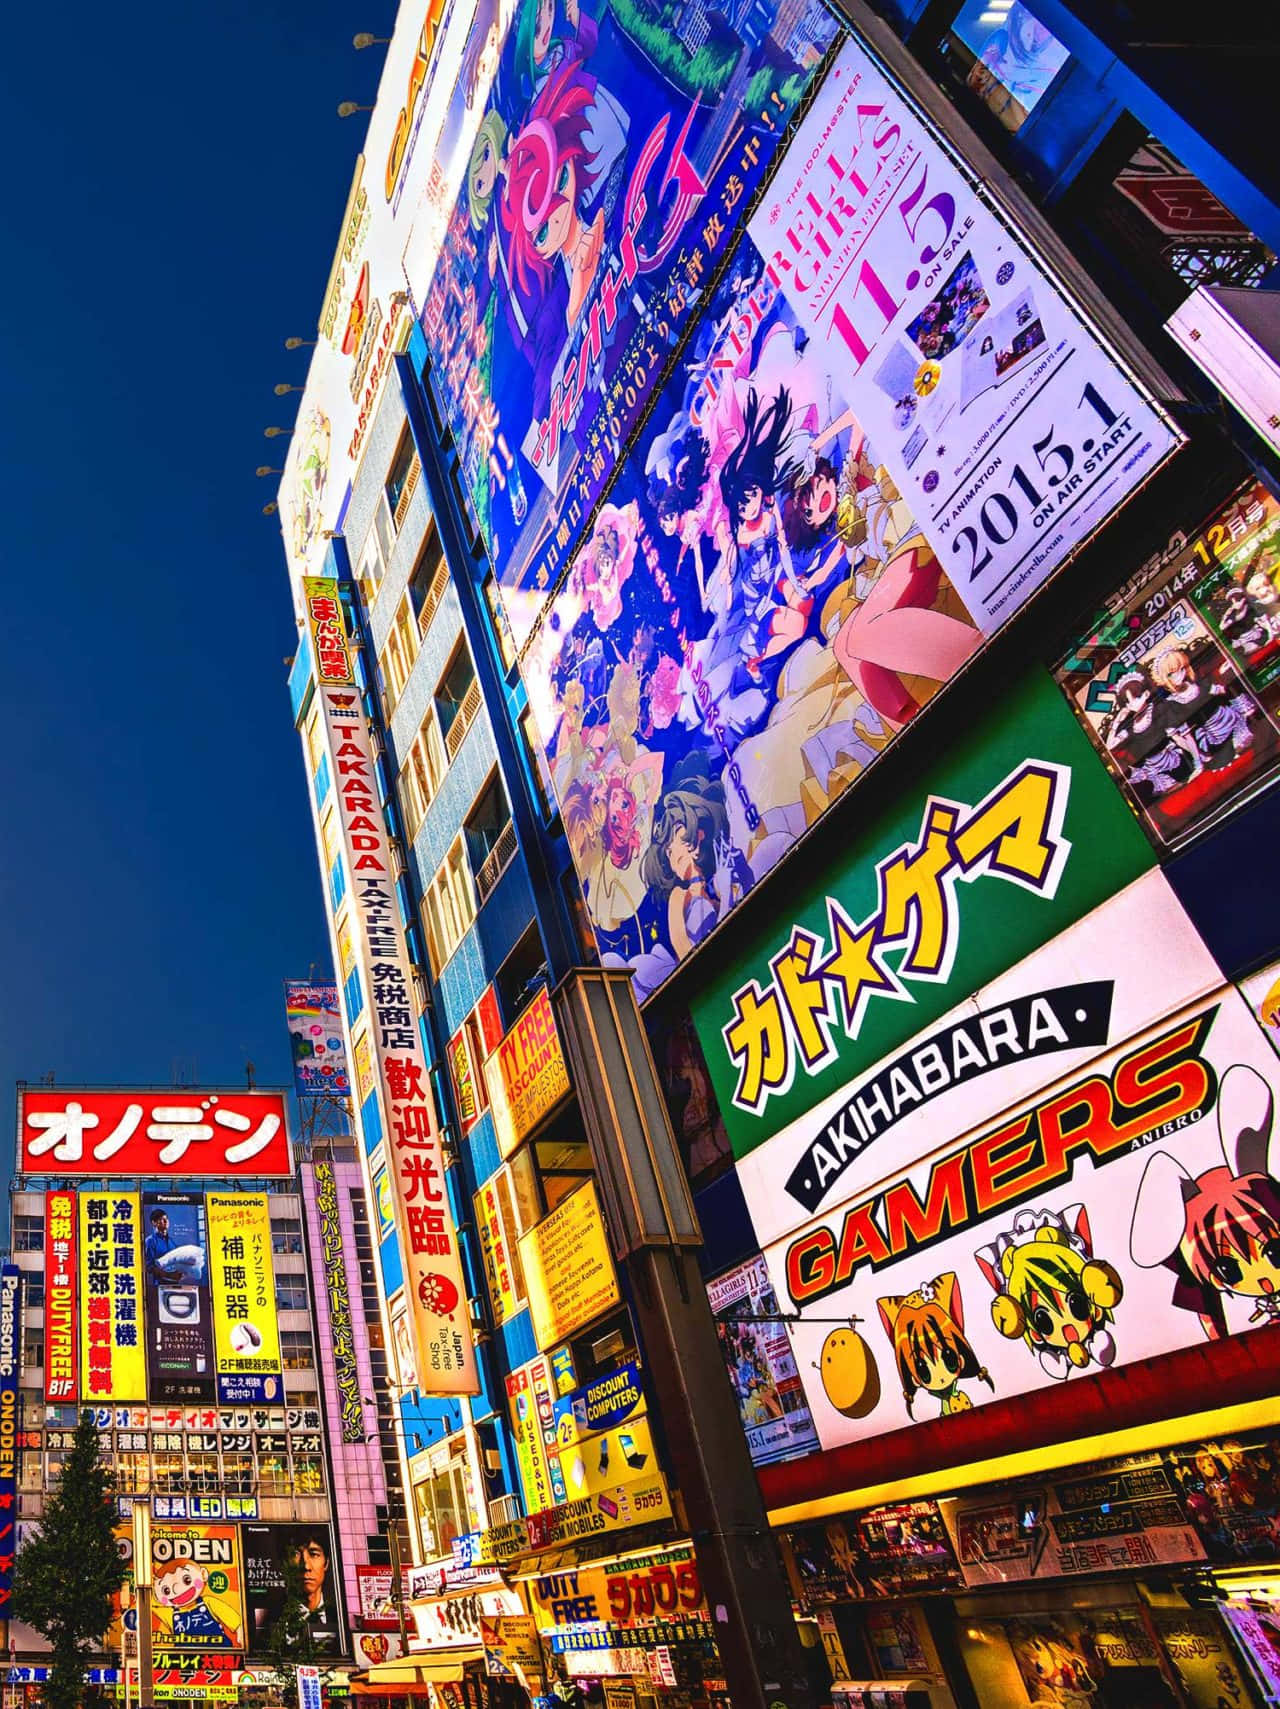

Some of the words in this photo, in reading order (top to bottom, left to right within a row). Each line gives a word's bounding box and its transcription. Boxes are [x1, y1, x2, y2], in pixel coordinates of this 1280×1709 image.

[785, 180, 805, 207] THE
[803, 70, 864, 176] IDOLM@STER
[793, 114, 902, 295] GIRLS
[687, 100, 887, 429] CINDERELLA
[826, 162, 956, 378] 11.5
[923, 262, 943, 290] ON
[942, 214, 977, 262] SALE
[530, 91, 786, 597] 週日曜日午前10:00より好評放送中!!
[937, 516, 953, 535] TV
[950, 456, 1003, 521] ANIMATION
[951, 380, 1126, 585] 2015.1
[1032, 504, 1056, 530] ON
[1057, 473, 1084, 505] AIR
[1083, 415, 1134, 475] START
[987, 532, 1065, 618] imas-cinderella.com
[310, 597, 352, 680] まんが喫茶
[331, 724, 387, 872] TAKARADA
[357, 877, 399, 959] TAX-FREE
[369, 963, 416, 1052] 免税商店
[517, 991, 556, 1067] FREE
[814, 997, 1068, 1188] AKIHABARA
[1129, 1108, 1204, 1151] ANIBRO
[26, 1095, 281, 1165] オノデン
[383, 1054, 452, 1257] 歓迎光臨
[785, 1003, 1223, 1306] GAMERS
[49, 1196, 73, 1240] 免税
[111, 1199, 135, 1269] 冷蔵庫
[210, 1198, 265, 1207] Panasonic
[220, 1234, 250, 1320] 補聴器
[251, 1233, 268, 1307] パナソニックの
[0, 1274, 18, 1378] Panasonic
[50, 1288, 73, 1379] DUTYFREE
[113, 1273, 137, 1347] 洗濯機
[429, 1334, 442, 1370] Shop
[441, 1327, 453, 1370] Tax-free
[450, 1330, 465, 1370] Japan.
[508, 1372, 528, 1395] 2F
[48, 1380, 74, 1396] B1F
[587, 1370, 630, 1404] DISCOUNT
[587, 1386, 640, 1422] COMPUTERS
[0, 1389, 15, 1479] ONODEN
[559, 1422, 574, 1444] 2F
[190, 1497, 222, 1517] LED
[526, 1521, 543, 1545] 2F
[551, 1498, 594, 1523] DISCOUNT
[549, 1526, 565, 1543] GSM
[564, 1512, 606, 1537] MOBILES
[116, 1537, 232, 1563] OODEN
[537, 1571, 580, 1601] DUTY
[551, 1594, 601, 1625] FREE
[172, 1687, 207, 1698] ONODEN
[489, 1660, 505, 1674] 2F
